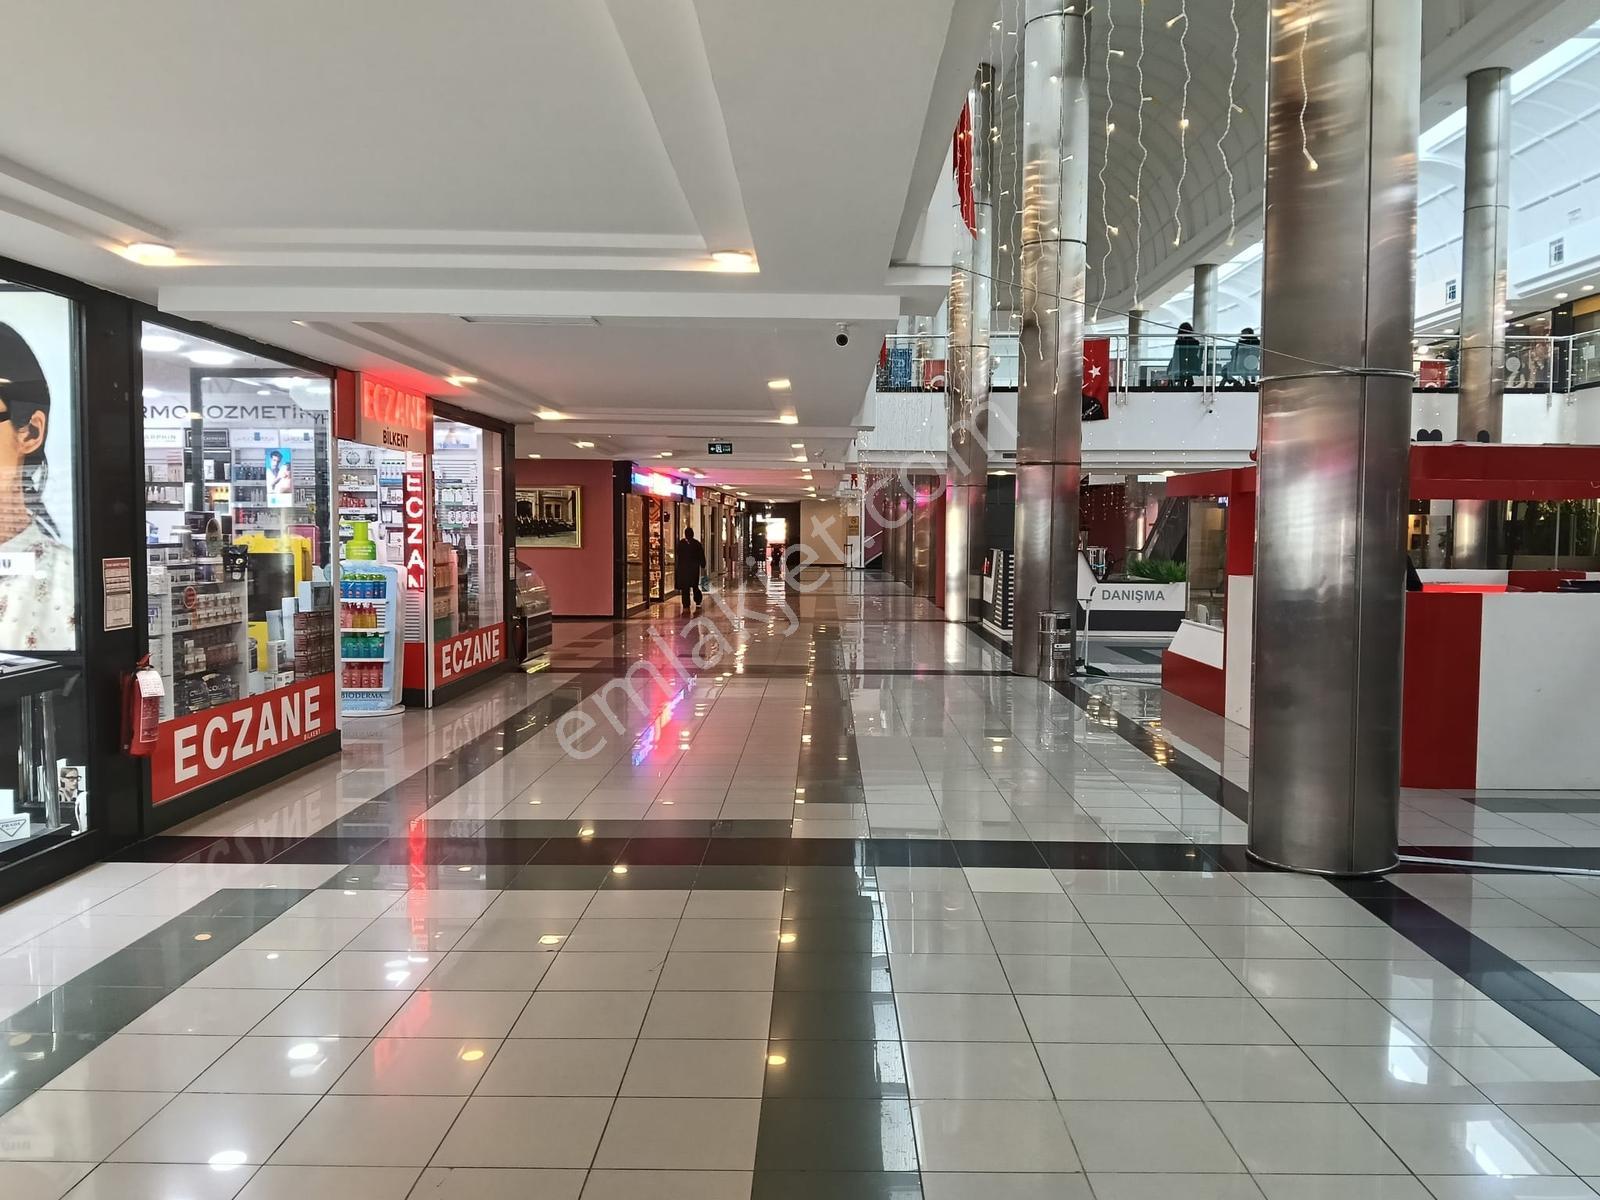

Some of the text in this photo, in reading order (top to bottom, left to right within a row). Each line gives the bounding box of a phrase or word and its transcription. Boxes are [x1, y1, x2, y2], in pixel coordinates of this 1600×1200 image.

[363, 380, 427, 432] ECZANE
[382, 426, 409, 449] BİLKENT
[1101, 589, 1165, 604] DANIŞMA
[441, 628, 500, 679] ECZANE
[174, 685, 321, 784] ECZANE
